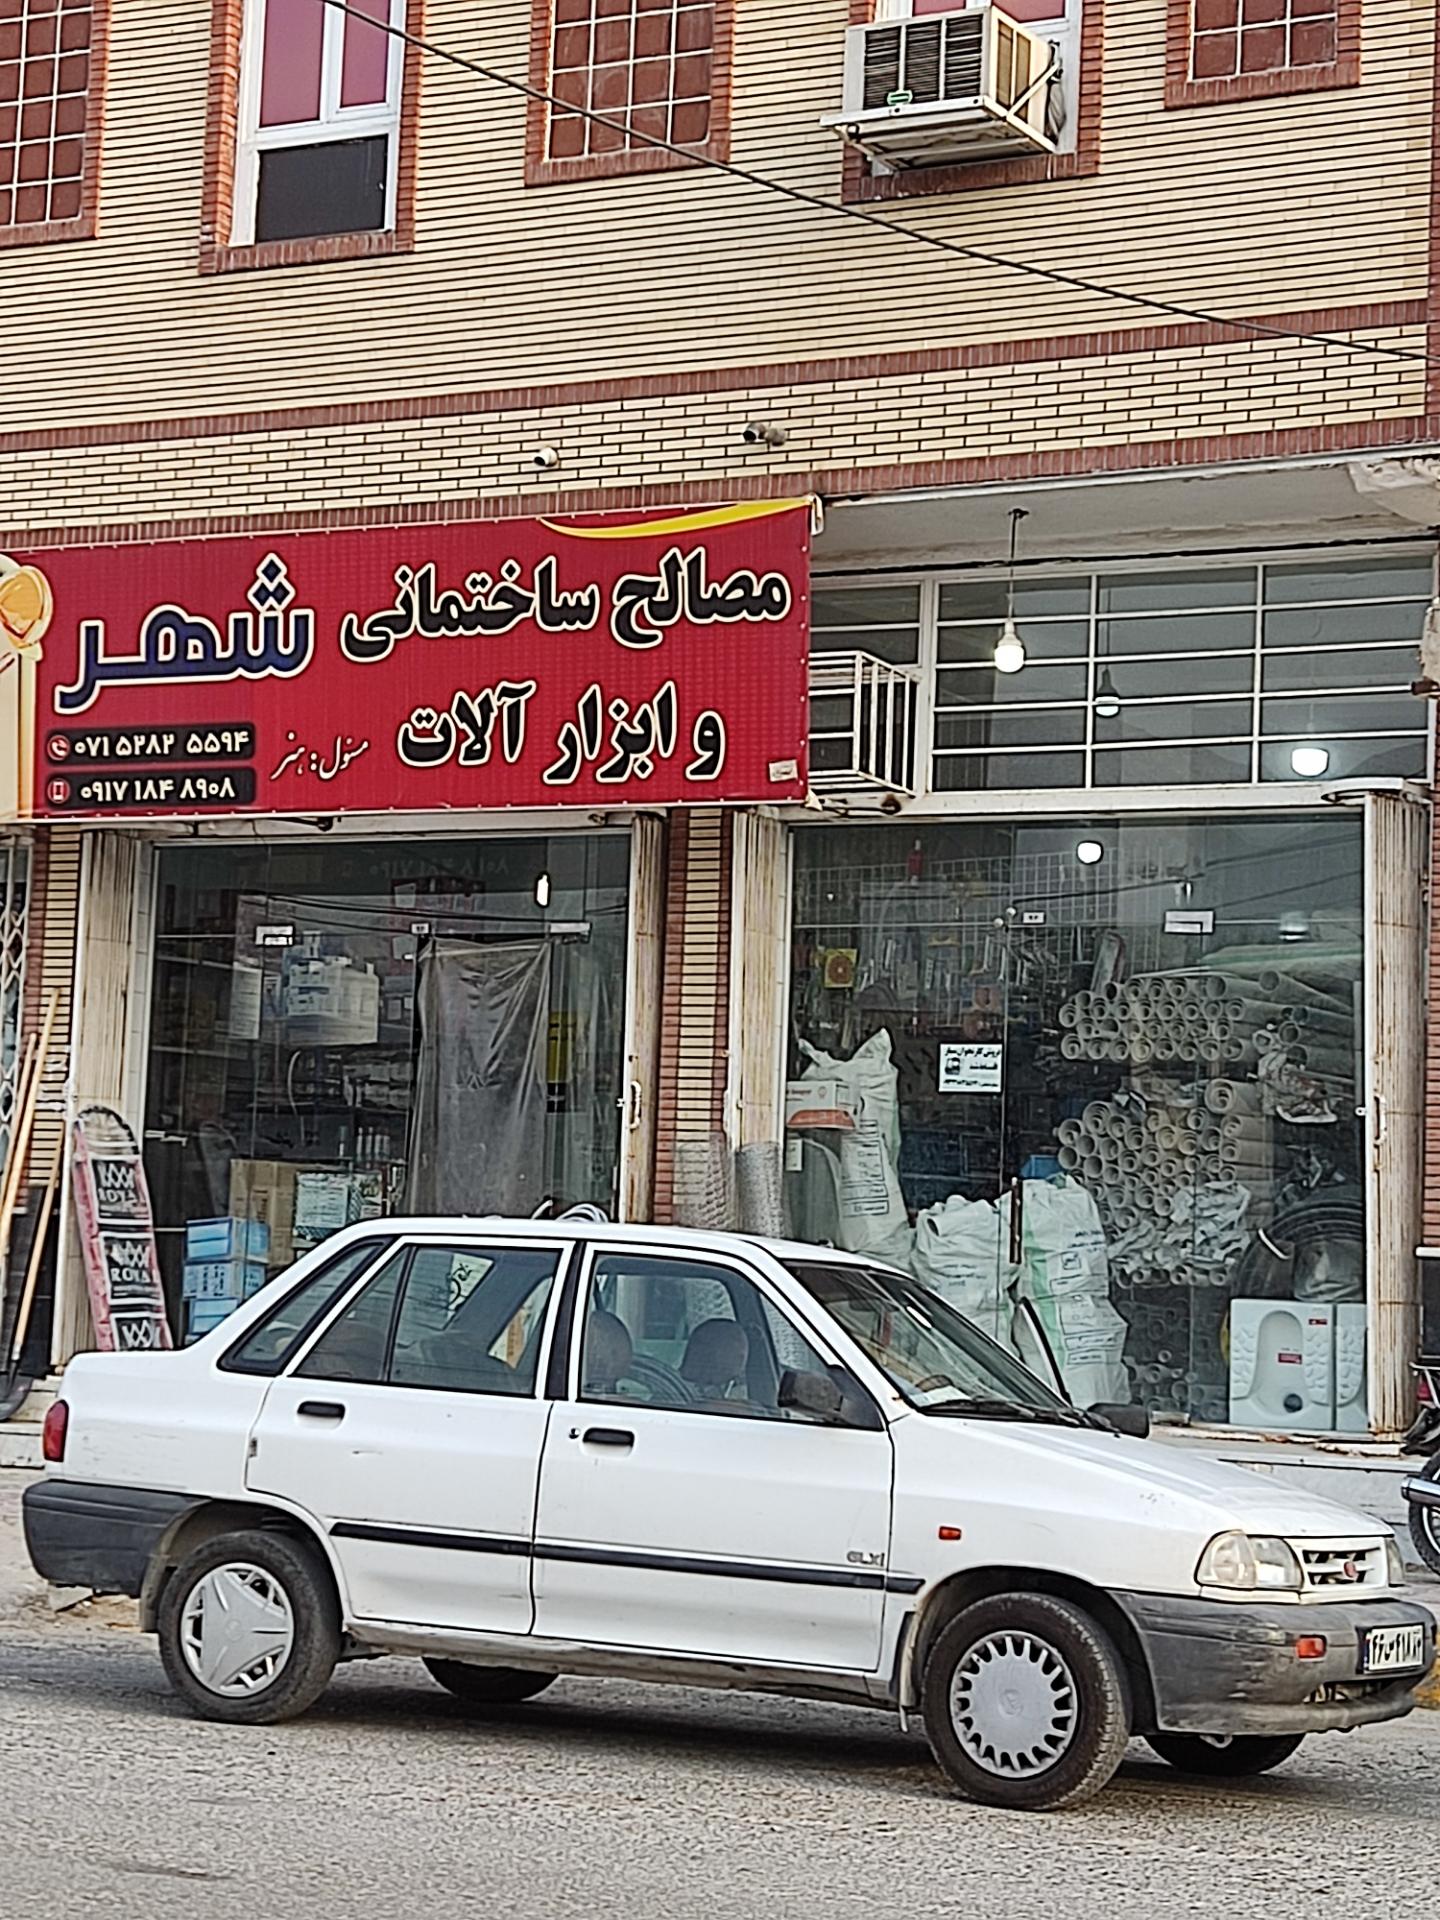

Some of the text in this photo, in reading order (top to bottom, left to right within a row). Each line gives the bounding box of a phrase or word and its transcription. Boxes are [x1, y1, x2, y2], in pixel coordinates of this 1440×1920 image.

[54, 547, 791, 714] مصالح ساختمانی شهر
[74, 731, 249, 757] ۰۷۱ ۵۲۸۲ ۵۵۹۴
[270, 731, 306, 780] هنر
[397, 680, 726, 784] و ابزار آلات
[80, 776, 236, 802] ۰۹۱۷ ۱۸۴ ۸۹۰۸
